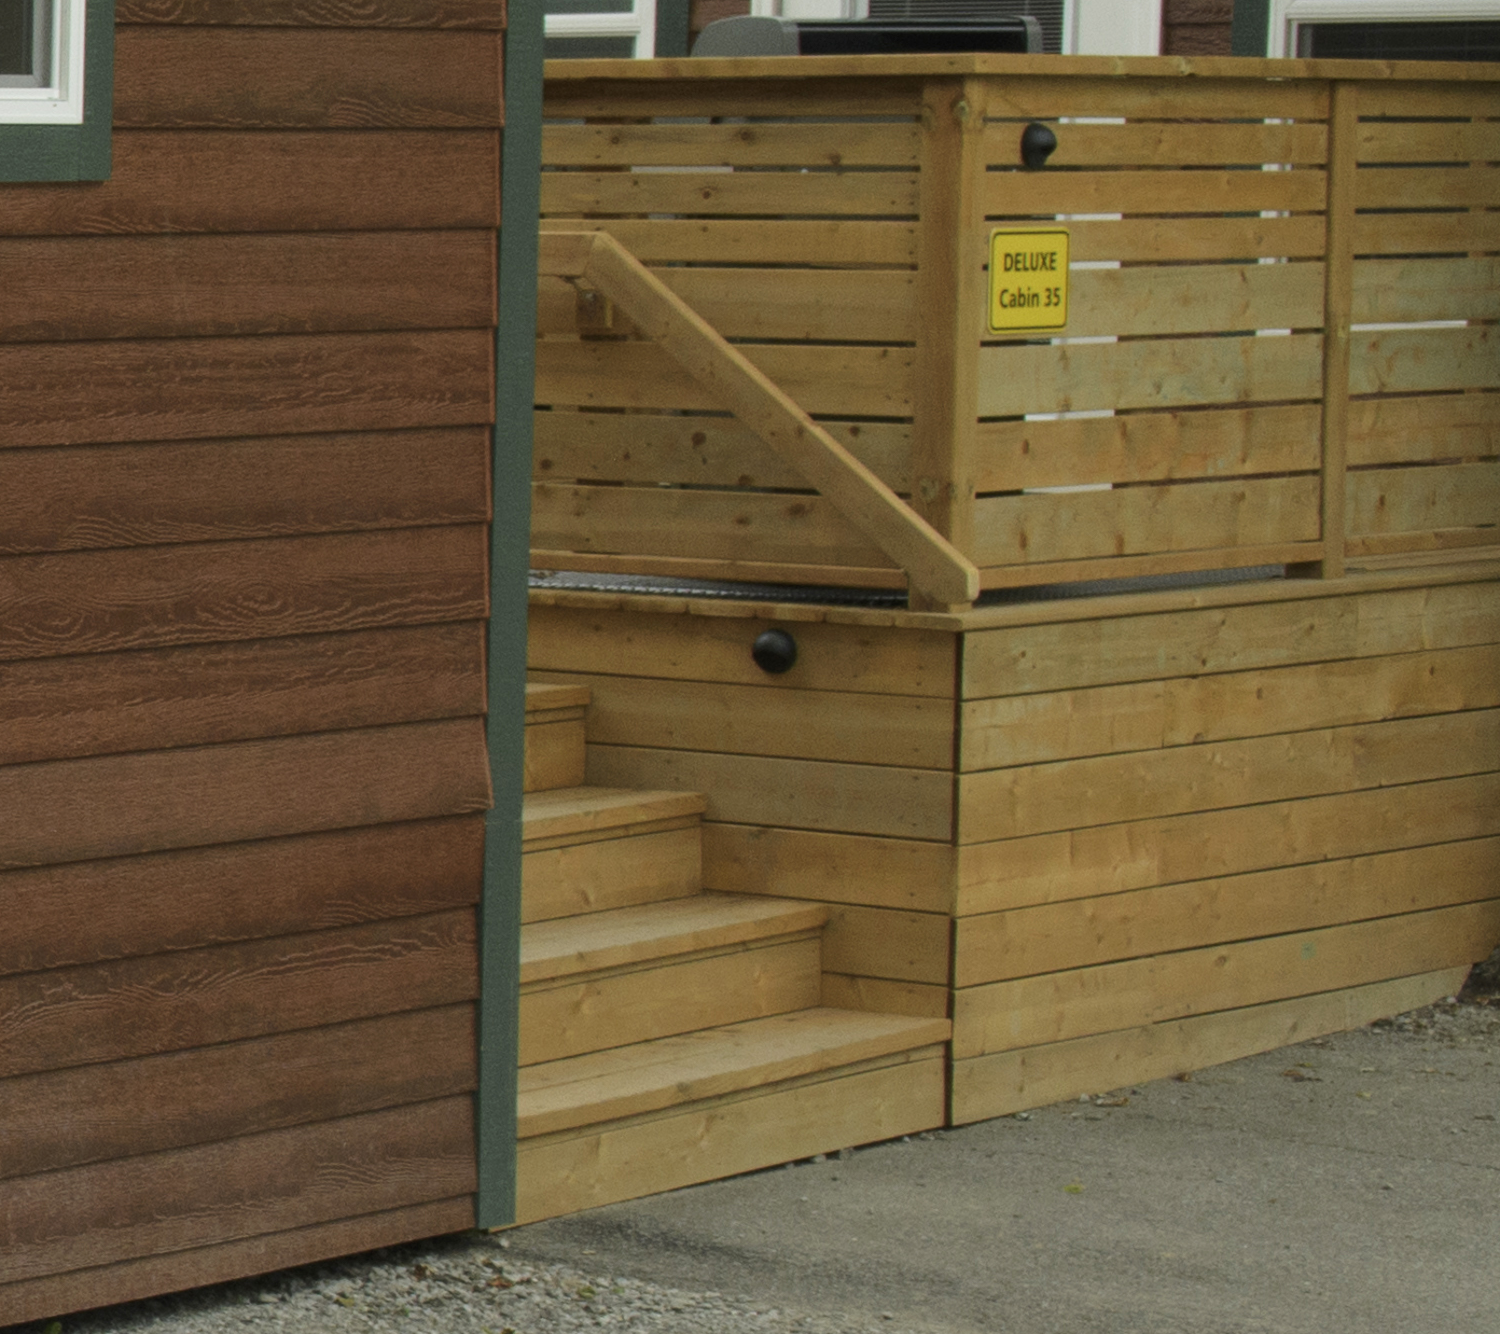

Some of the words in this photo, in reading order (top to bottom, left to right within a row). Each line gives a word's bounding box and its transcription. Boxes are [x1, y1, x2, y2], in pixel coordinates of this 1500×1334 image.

[1003, 252, 1057, 272] DELUXE
[999, 287, 1040, 309] Cabin
[1043, 287, 1061, 307] 35
